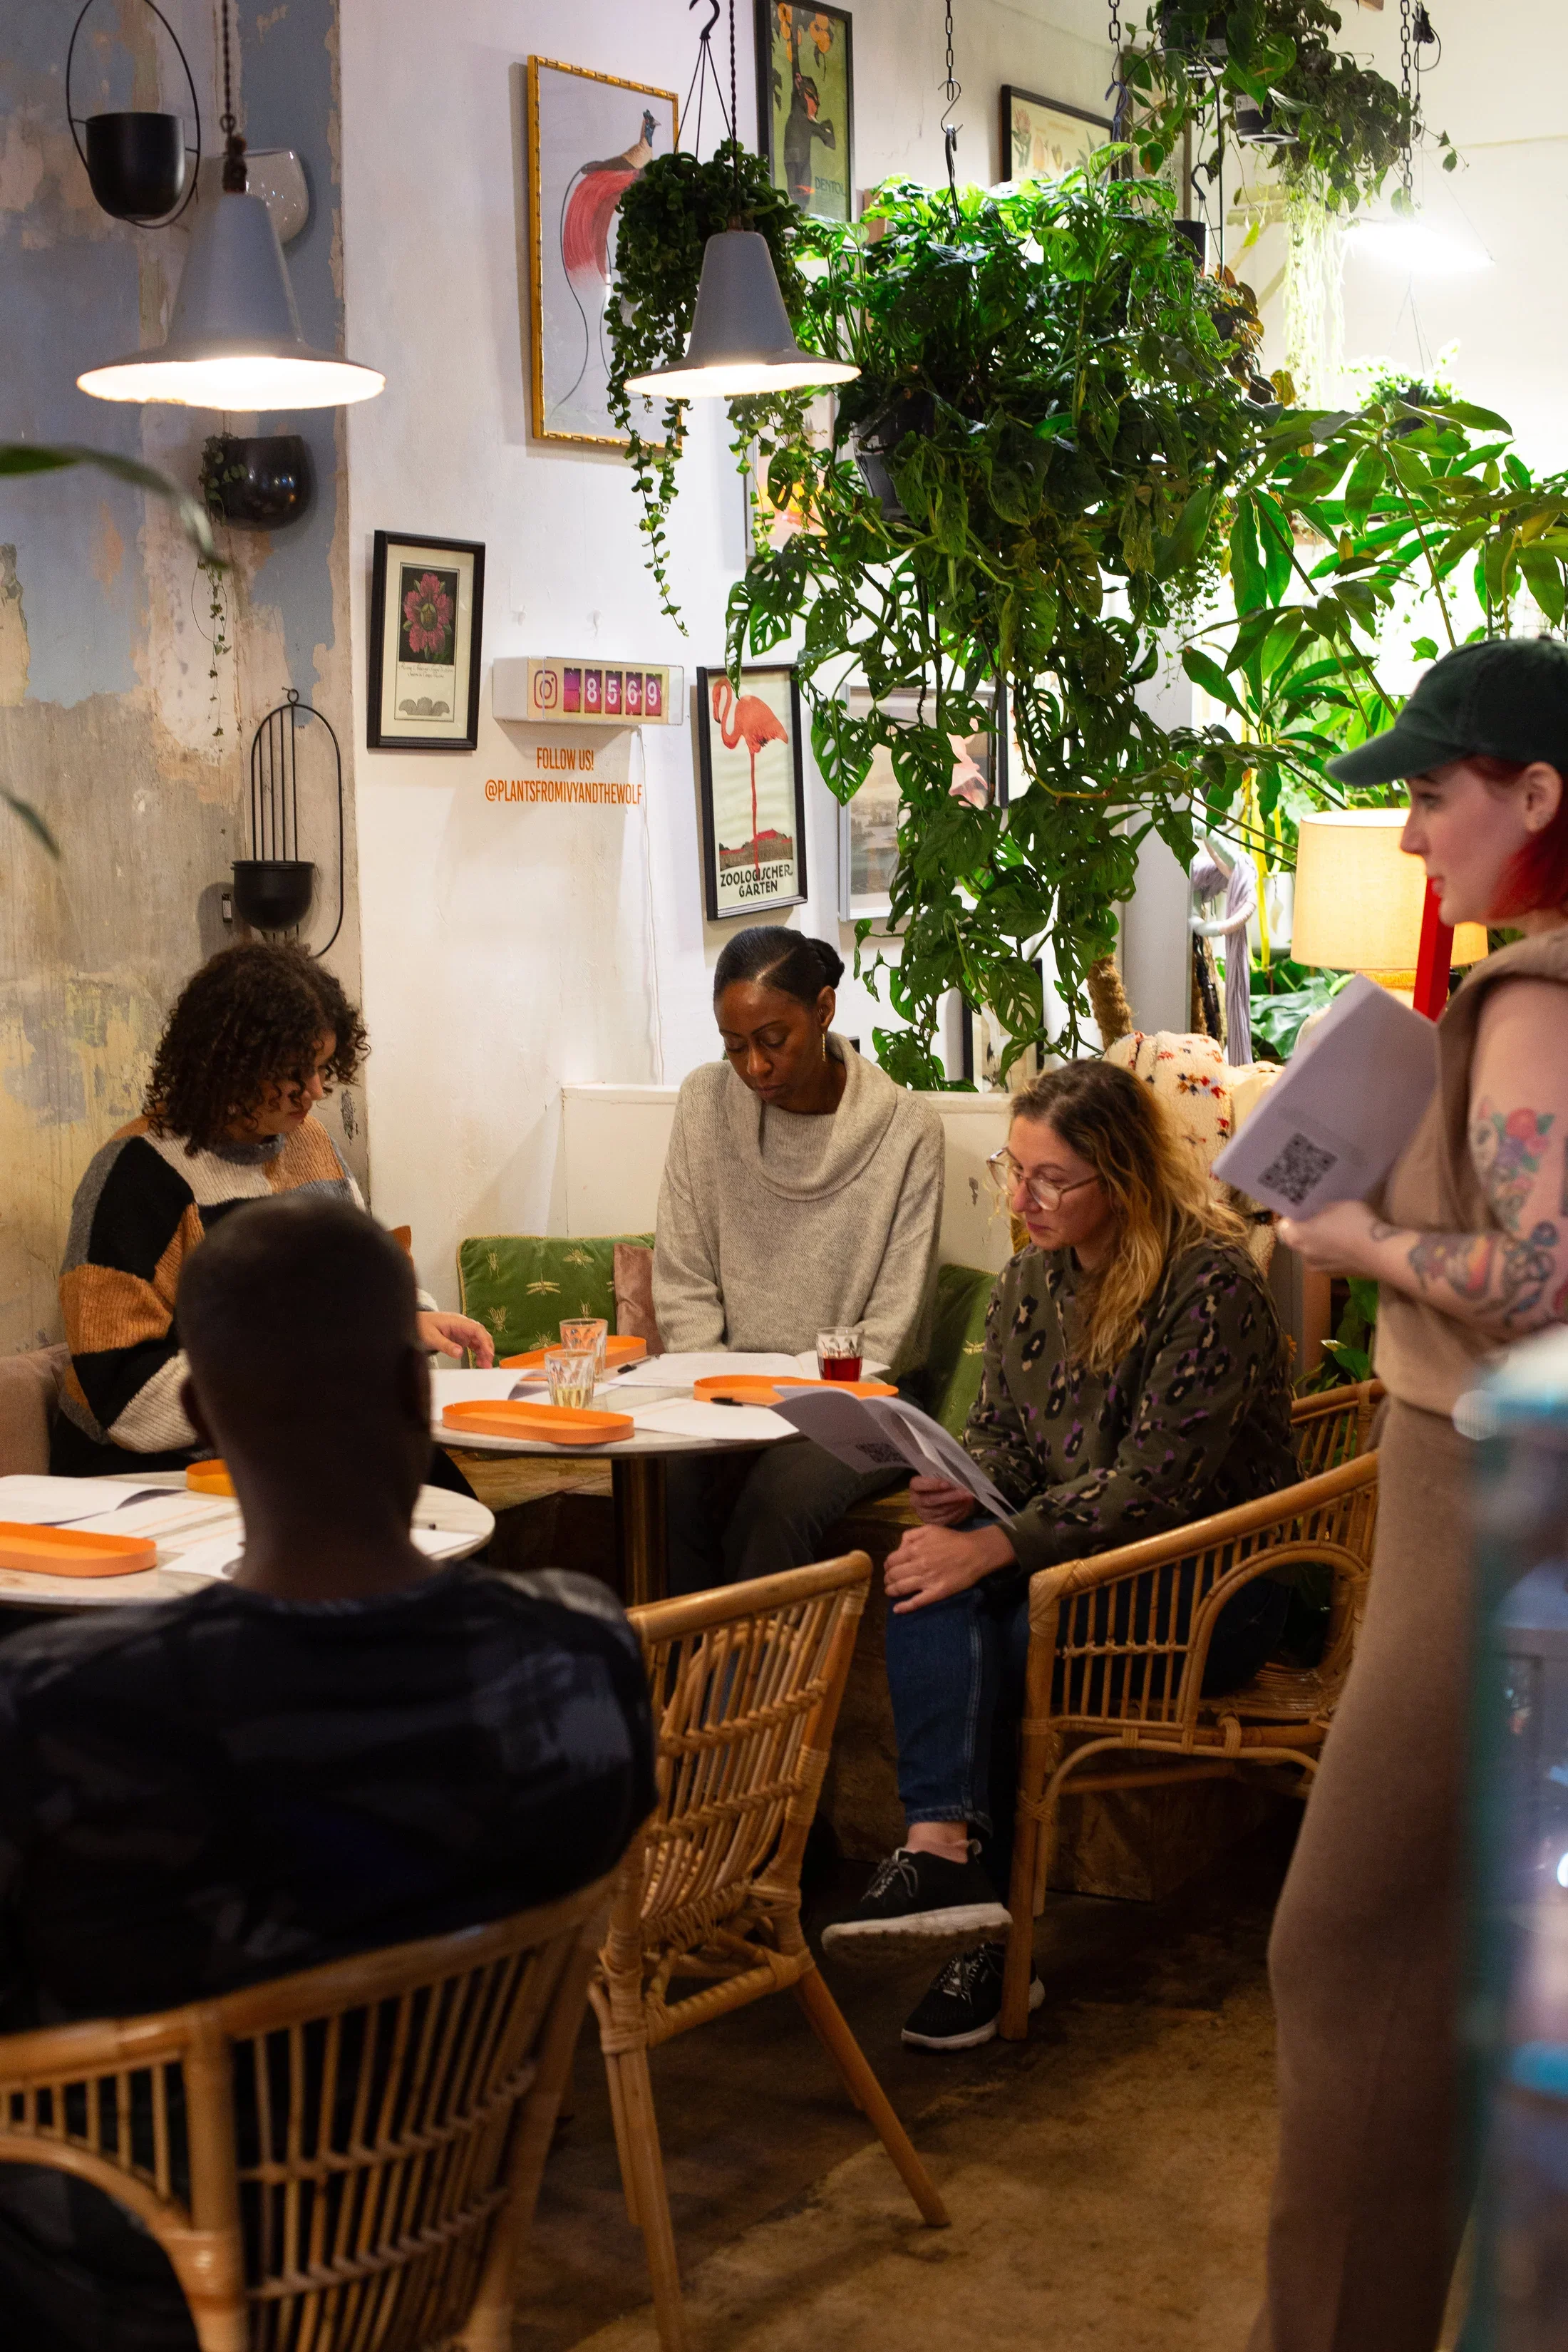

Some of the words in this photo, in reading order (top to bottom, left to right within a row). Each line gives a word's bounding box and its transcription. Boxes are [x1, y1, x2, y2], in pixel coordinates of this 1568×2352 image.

[537, 747, 575, 770] FOLLOW
[579, 749, 594, 770] US!
[485, 779, 641, 804] @PLANTSFROMIVYANDTHEWOLF
[720, 864, 793, 887] ZOOLOGISCHER
[738, 880, 778, 897] GARTEN
